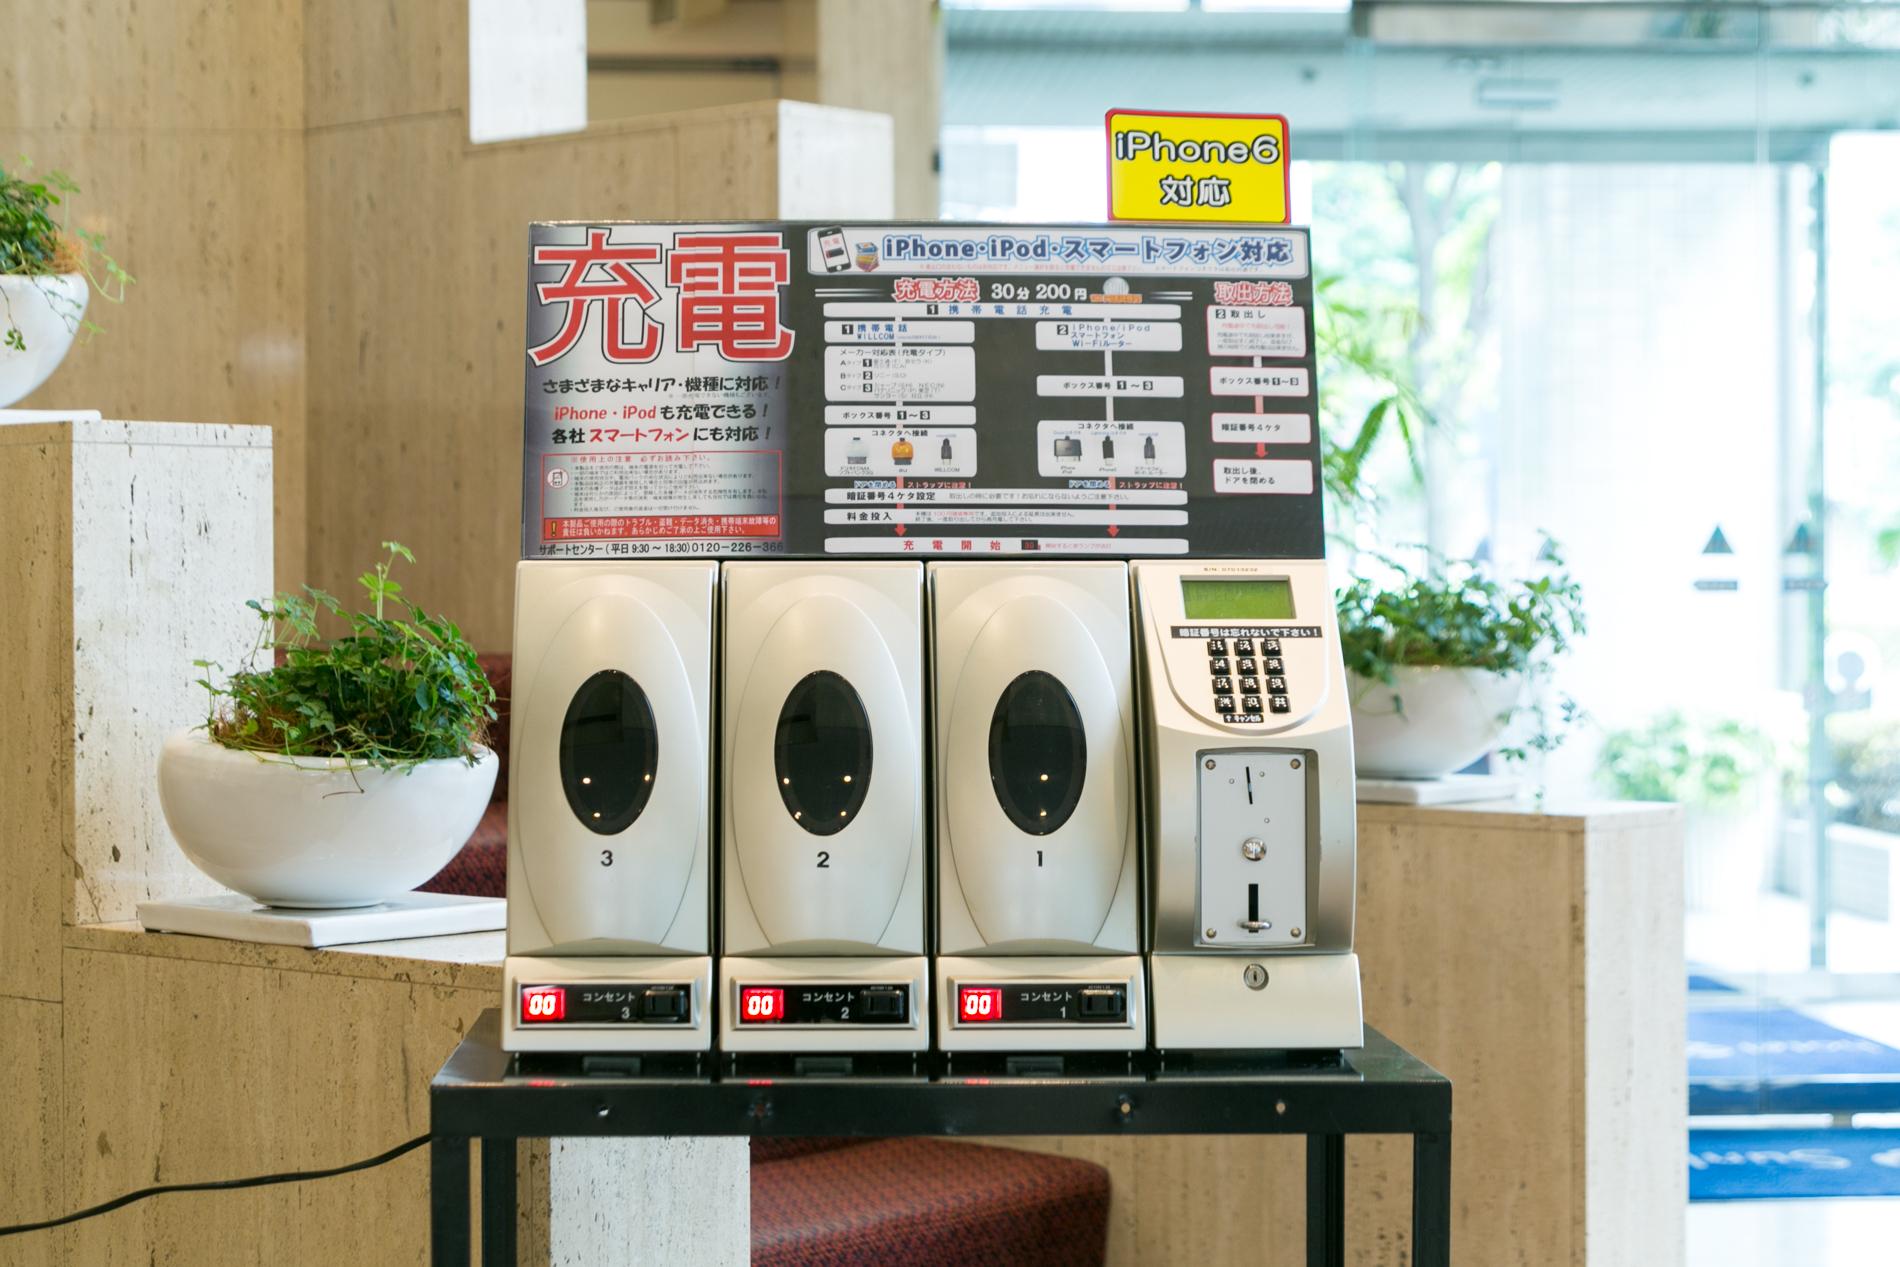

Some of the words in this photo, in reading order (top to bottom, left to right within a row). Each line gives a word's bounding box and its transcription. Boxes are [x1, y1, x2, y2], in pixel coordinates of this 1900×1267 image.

[1115, 130, 1280, 165] iPhone6
[1159, 174, 1232, 207] 対応
[882, 234, 1293, 267] iPhone・iPod・スマートフォン対応
[527, 226, 795, 367] 充電
[892, 278, 980, 302] 充電方法
[991, 283, 1030, 300] 30分
[1036, 283, 1088, 300] 200円
[1214, 280, 1295, 306] 取出方法
[949, 305, 1072, 315] 携帯電話充電
[1230, 310, 1266, 318] 取出し
[858, 324, 908, 333] 携帯電話
[1220, 377, 1270, 385] ボックス番号
[843, 411, 891, 420] ボックス番号
[1078, 423, 1134, 431] コネクタへ接続
[846, 491, 935, 500] 暗証番号4ケタ設定
[847, 511, 892, 520] 料金投入
[903, 540, 1001, 550] 充電開始
[601, 849, 613, 867] 3
[817, 851, 830, 868] 2
[1036, 850, 1043, 867] 1
[583, 991, 636, 1003] コンセント
[802, 992, 855, 1003] コンセント
[1020, 991, 1073, 1002] コンセント
[529, 994, 557, 1016] 00
[747, 995, 774, 1016] 00
[965, 994, 992, 1015] 00
[621, 1006, 630, 1020] 3
[841, 1007, 849, 1019] 2
[1060, 1006, 1067, 1019] 1
